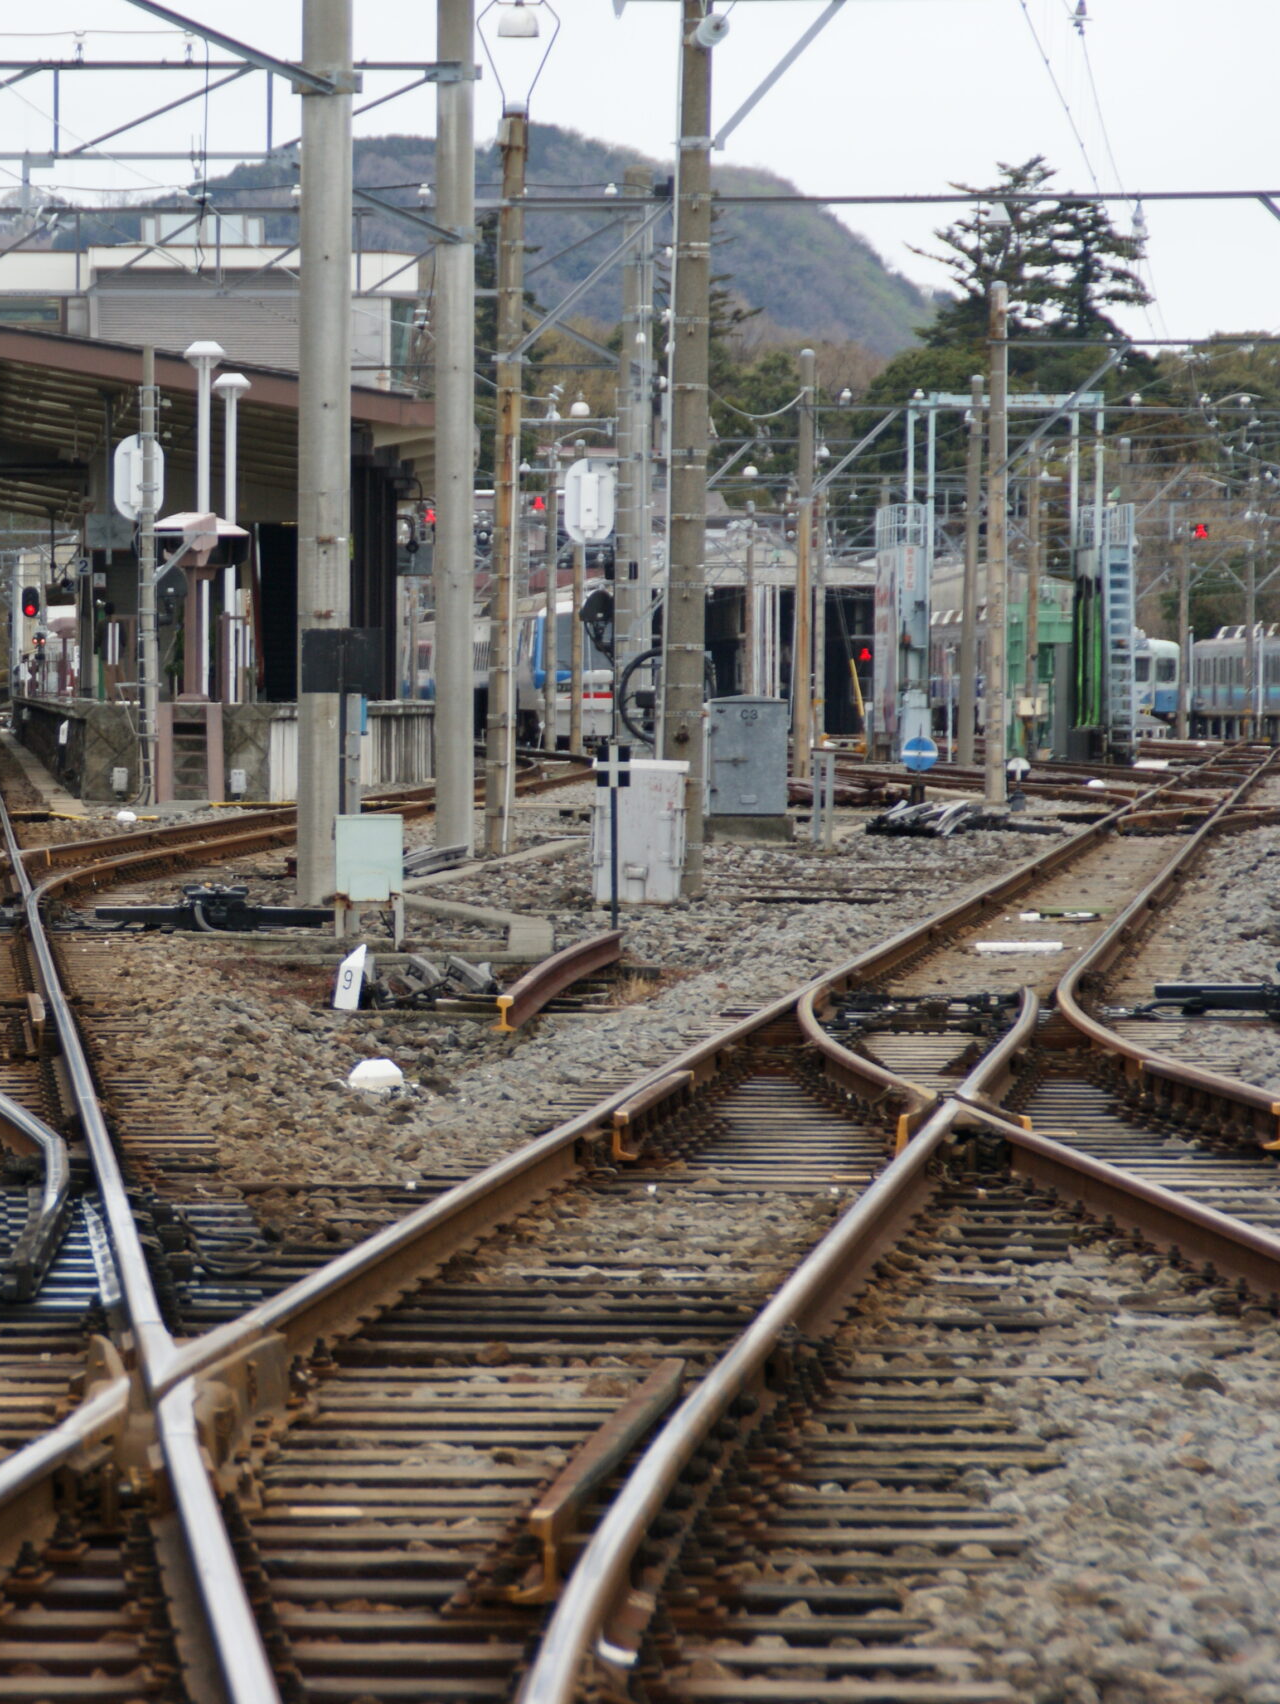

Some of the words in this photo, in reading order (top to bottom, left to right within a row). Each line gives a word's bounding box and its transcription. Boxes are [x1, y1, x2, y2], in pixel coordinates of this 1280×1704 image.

[79, 559, 89, 573] 2
[740, 709, 758, 720] C3
[342, 969, 353, 990] 9
